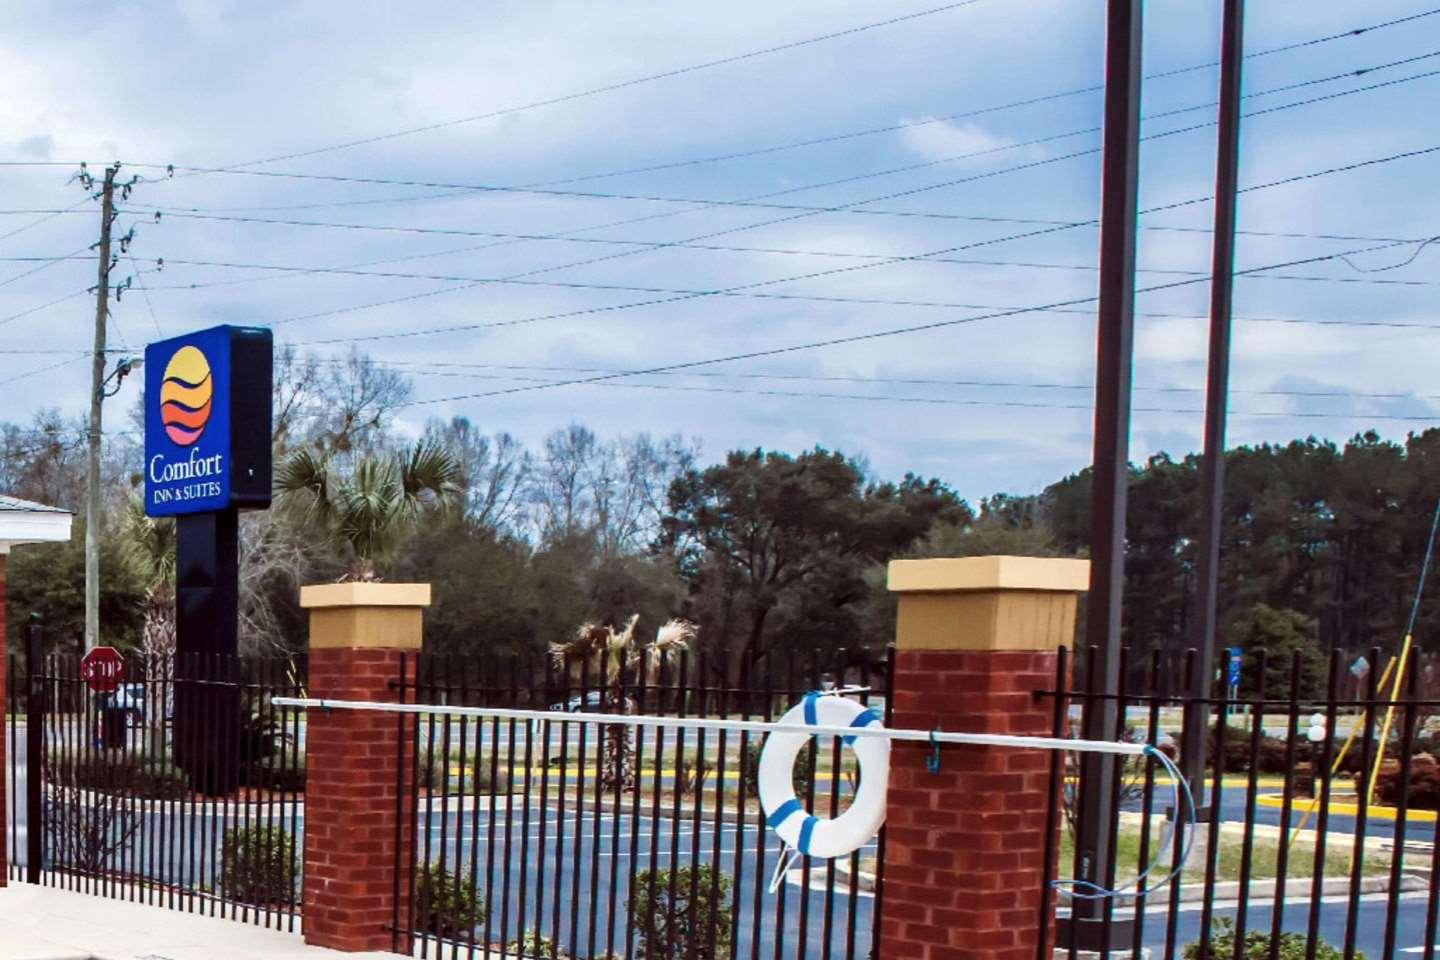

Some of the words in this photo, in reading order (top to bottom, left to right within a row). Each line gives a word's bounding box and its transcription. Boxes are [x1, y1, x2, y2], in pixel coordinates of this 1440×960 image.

[150, 447, 223, 483] Comfort
[154, 487, 174, 504] INN
[175, 488, 182, 500] &
[183, 481, 221, 500] SUITES
